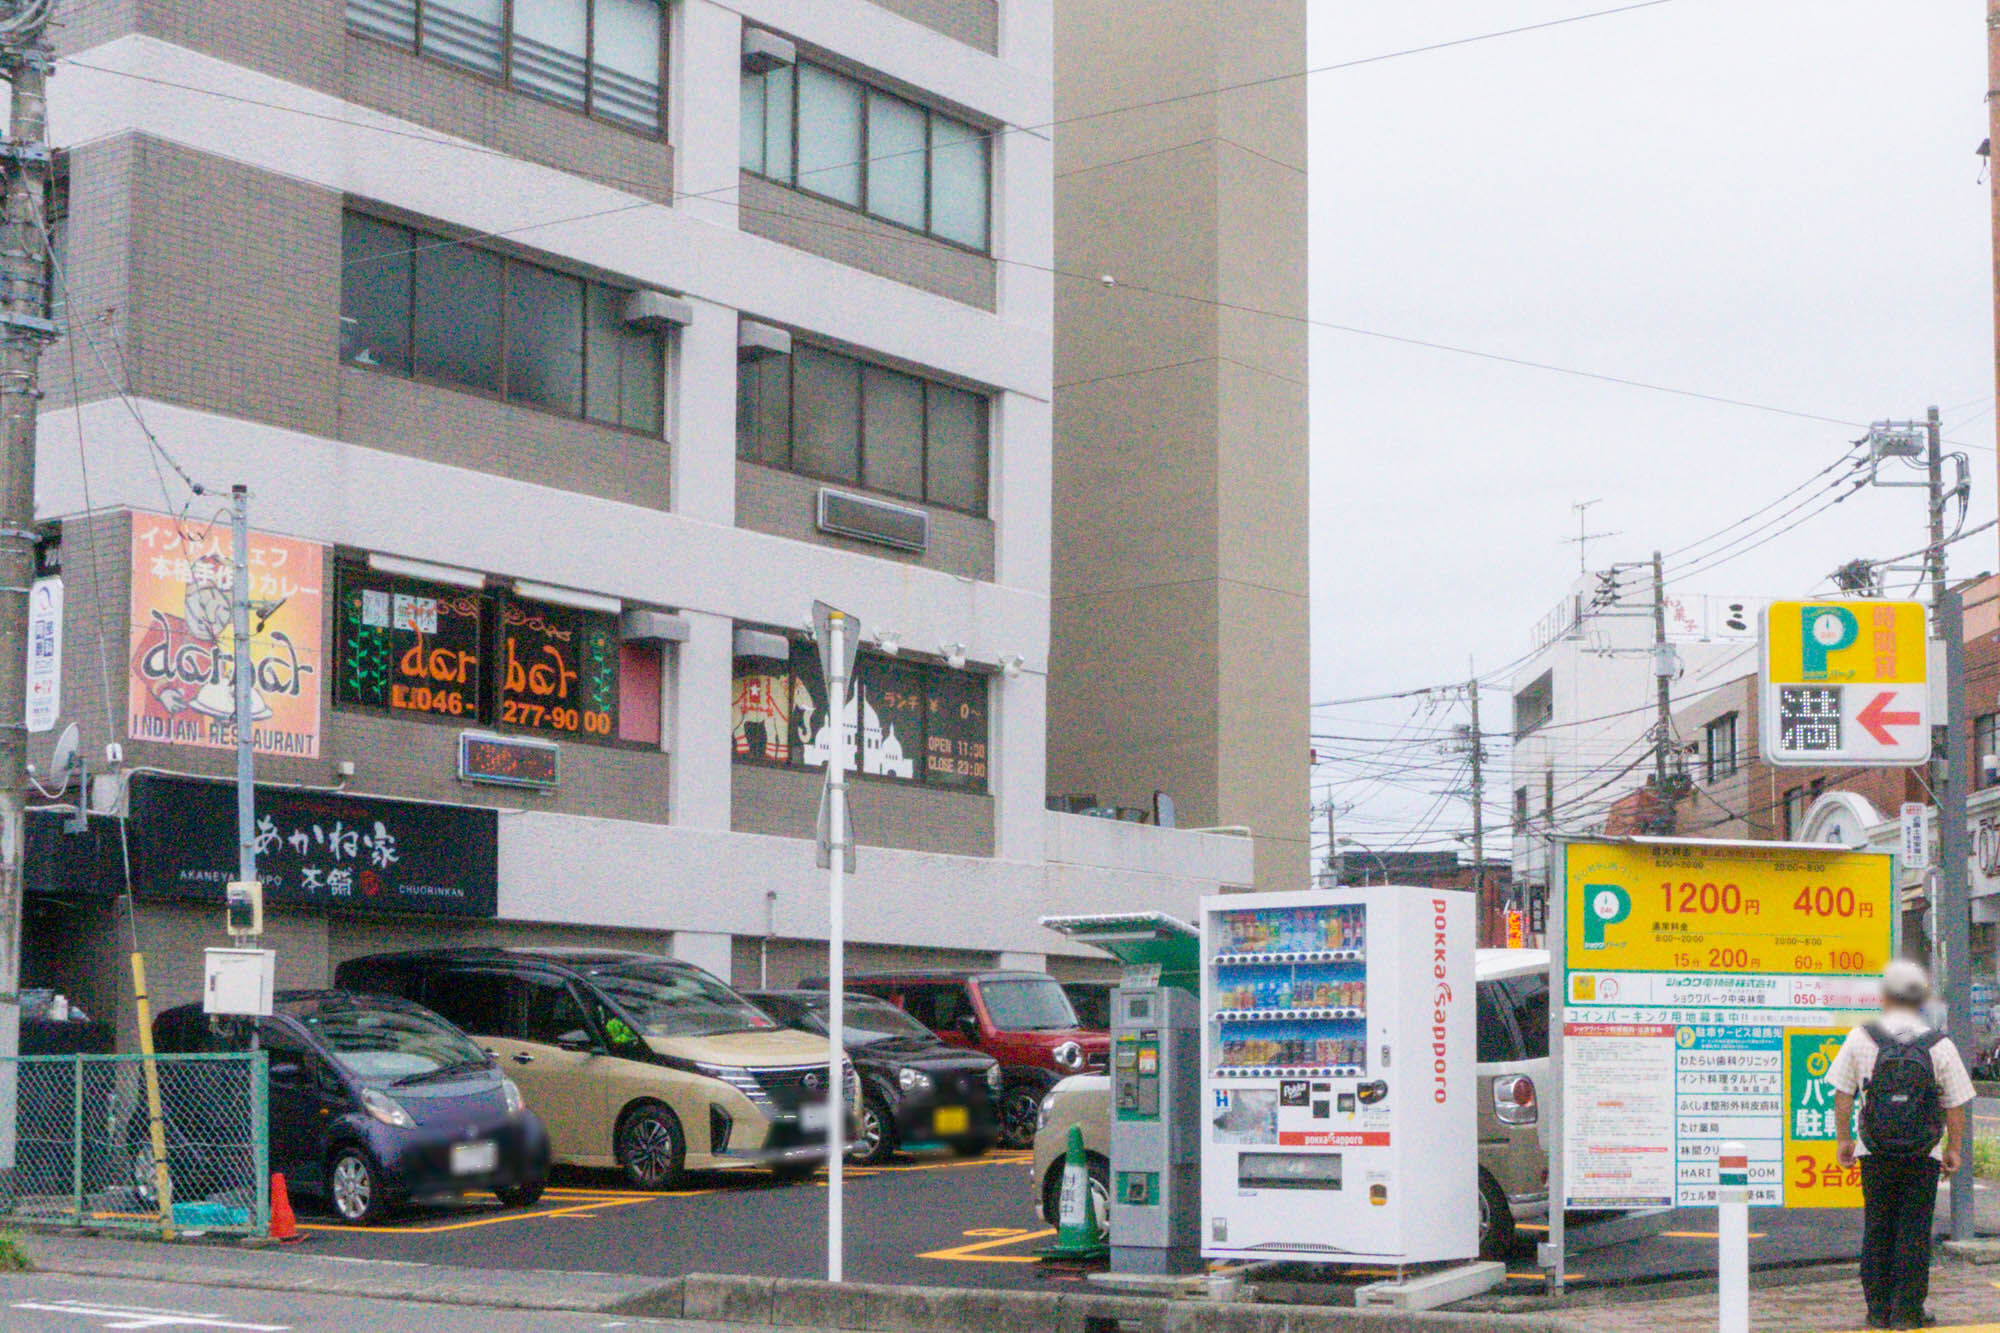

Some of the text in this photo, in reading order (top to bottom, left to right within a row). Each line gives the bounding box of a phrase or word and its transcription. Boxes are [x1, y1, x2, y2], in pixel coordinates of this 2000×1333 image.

[1873, 604, 1897, 679] 時間貸
[133, 715, 316, 755] INDIAN RESAURANT
[398, 884, 465, 898] CHUORINKAN
[1680, 1055, 1778, 1067] わたらい歯科クリニック
[1680, 1122, 1720, 1134] たけ薬局
[1680, 1144, 1720, 1156] 林間クリ
[1680, 1167, 1776, 1178] HARI OOM
